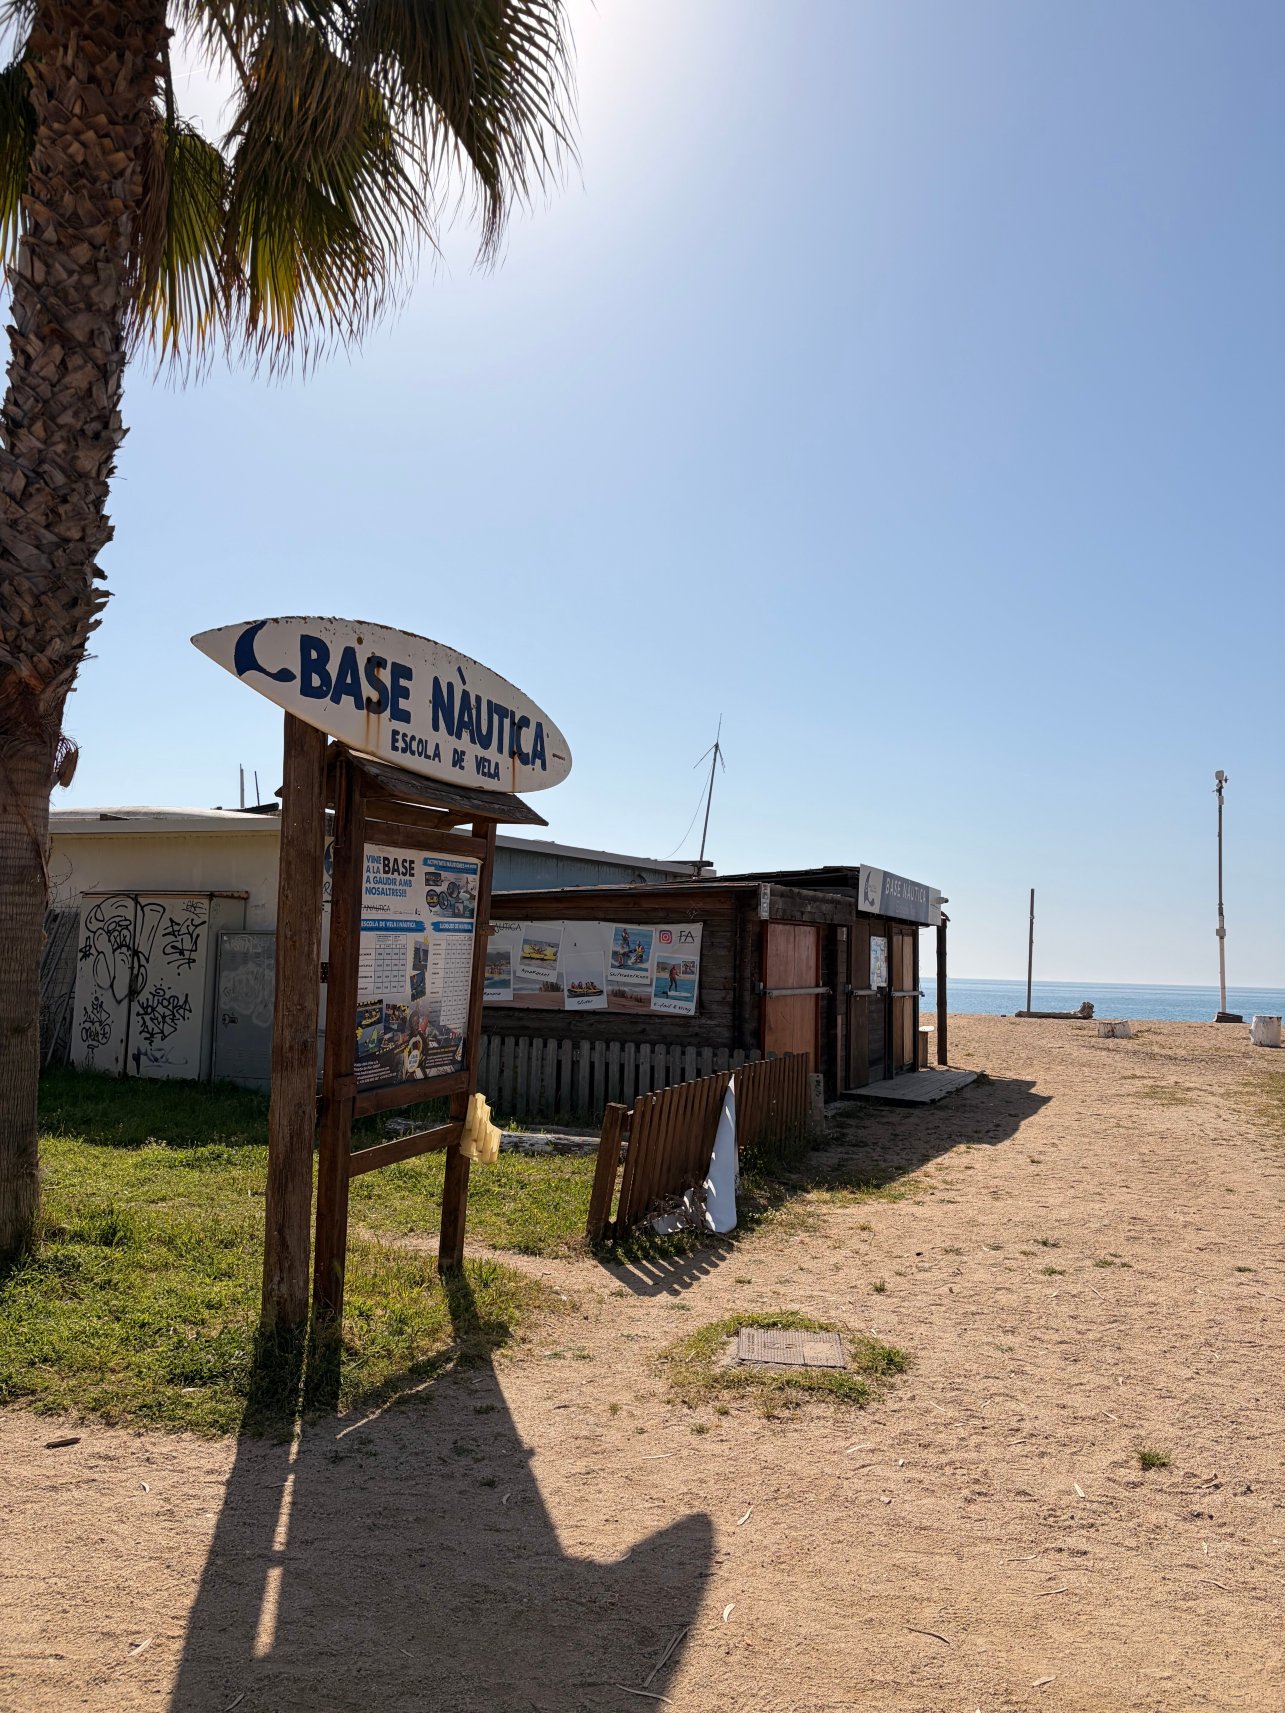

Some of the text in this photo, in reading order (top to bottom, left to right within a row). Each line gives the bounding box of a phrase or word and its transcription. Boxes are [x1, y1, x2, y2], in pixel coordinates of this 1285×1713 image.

[299, 634, 547, 772] BASE NÀUTICA
[390, 729, 501, 782] ESCOLA DE VELA
[365, 866, 381, 875] A LA
[382, 856, 415, 877] BASE
[365, 876, 413, 888] A GAUDIR AMB
[885, 877, 902, 897] BASE
[902, 881, 927, 905] NÀUTICA
